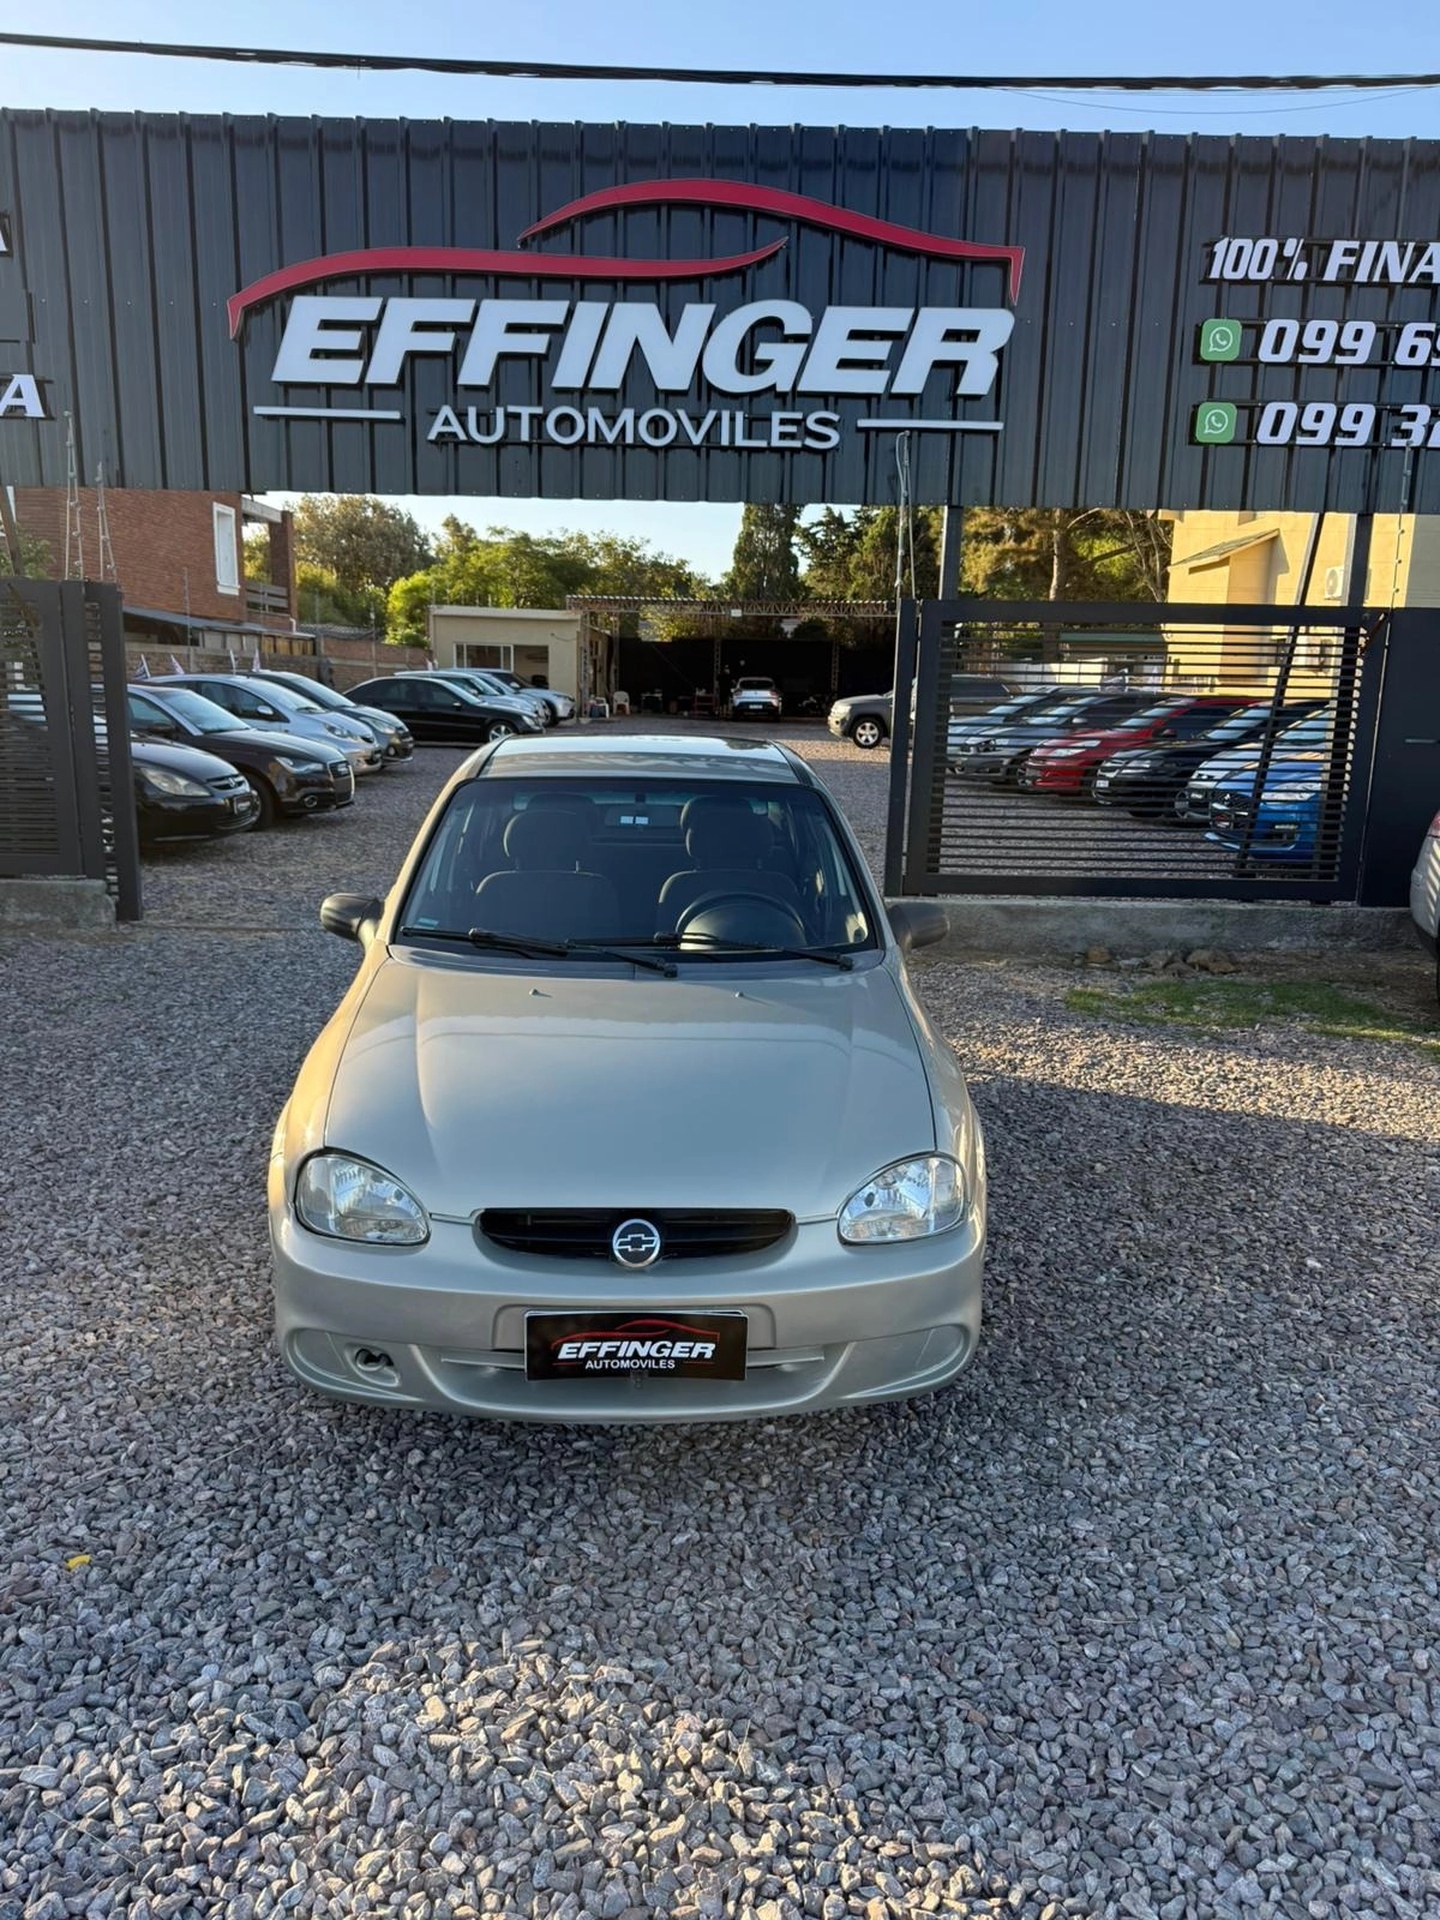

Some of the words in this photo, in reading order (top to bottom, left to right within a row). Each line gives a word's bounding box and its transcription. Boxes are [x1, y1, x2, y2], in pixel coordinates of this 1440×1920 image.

[1209, 237, 1308, 280] 100%
[271, 295, 1015, 395] EFFINGER
[1258, 319, 1376, 364] 099
[1394, 322, 1440, 366] 6
[427, 405, 840, 449] AUTOMOVILES
[1256, 402, 1376, 446] 099
[557, 1341, 716, 1360] EFFINGER
[585, 1359, 676, 1370] AUTOMOVILES
